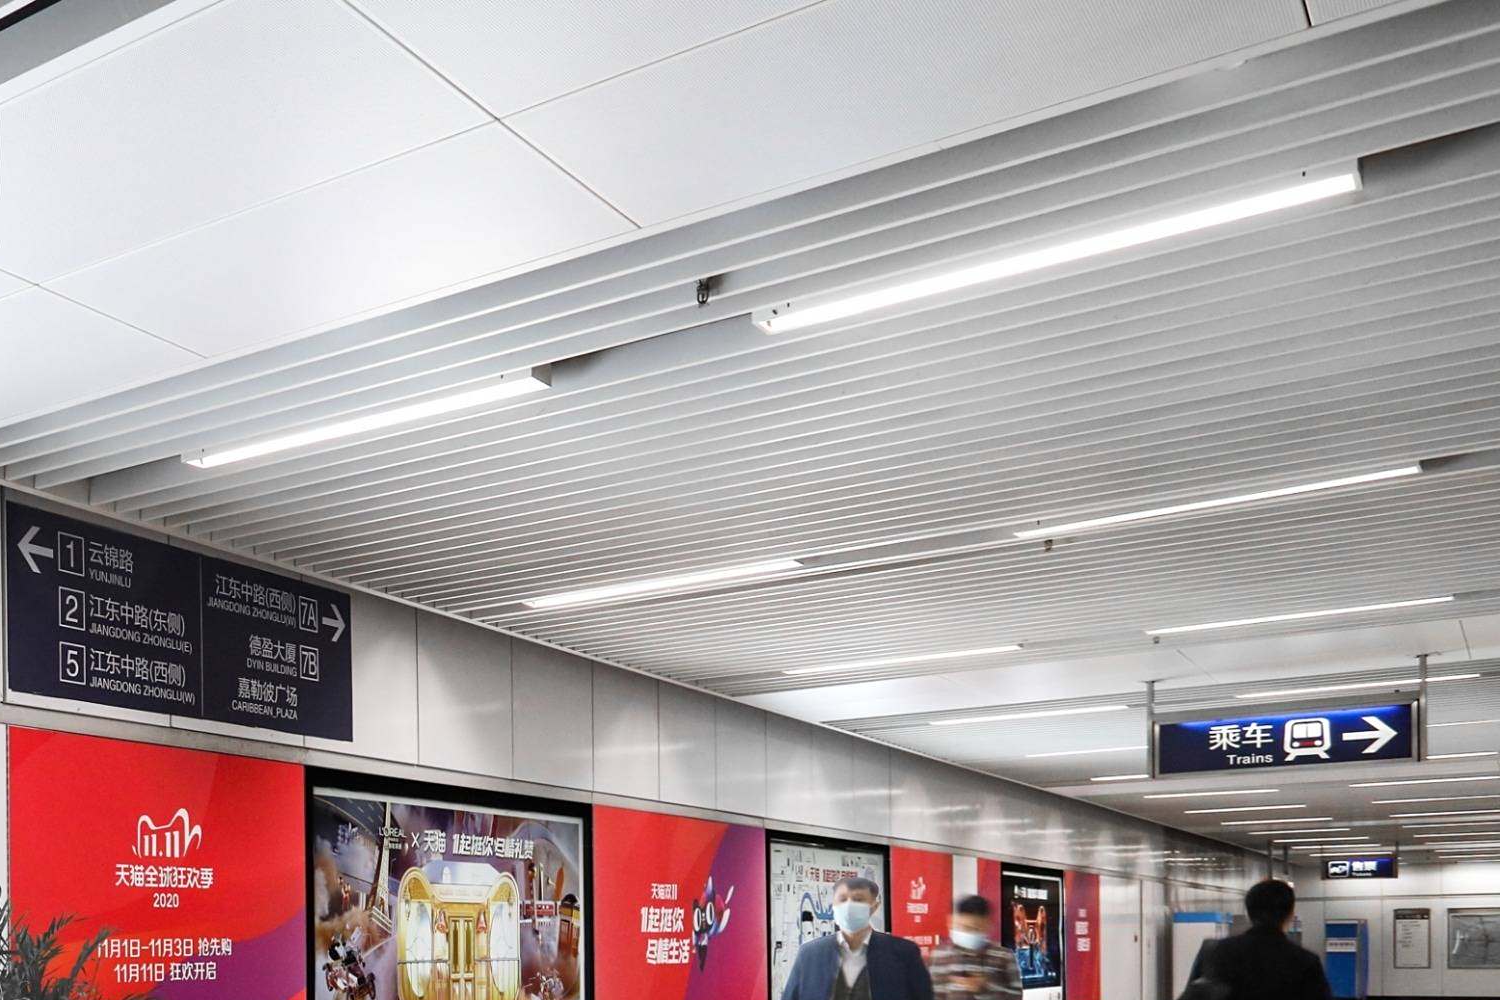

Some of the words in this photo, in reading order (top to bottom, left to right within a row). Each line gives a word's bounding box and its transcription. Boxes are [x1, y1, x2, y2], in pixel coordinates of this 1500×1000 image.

[66, 541, 75, 568] 1
[89, 541, 133, 573] 云锦路
[89, 568, 131, 588] YUNJINLU
[207, 596, 251, 616] JIANGDONG
[215, 574, 296, 613] 江东中路(西侧)
[66, 595, 78, 623] 2
[89, 594, 185, 637] 江东中路(东侧)
[301, 602, 317, 627] 7A
[89, 623, 140, 643] JIANGDONG
[143, 633, 192, 655] ZHONGLU(E)
[249, 634, 297, 664] 德盈大厦
[66, 650, 79, 677] 5
[90, 648, 186, 688] 江东中路(西侧)
[247, 658, 264, 671] DYIN
[265, 662, 297, 677] BUILDING
[302, 651, 317, 676] 7B
[90, 676, 141, 695] JIANGDONG
[143, 685, 195, 706] ZHONGLU(W)
[276, 707, 298, 720] PLAZA
[1208, 722, 1274, 751] 乘车
[1226, 753, 1274, 766] Trains
[424, 829, 446, 853] 天猫
[115, 863, 214, 889] 天猫全球狂欢季
[153, 893, 179, 908] 2020
[198, 937, 232, 956] 抢先购
[114, 963, 164, 983] 11月11日
[169, 961, 216, 981] 狂欢开启
